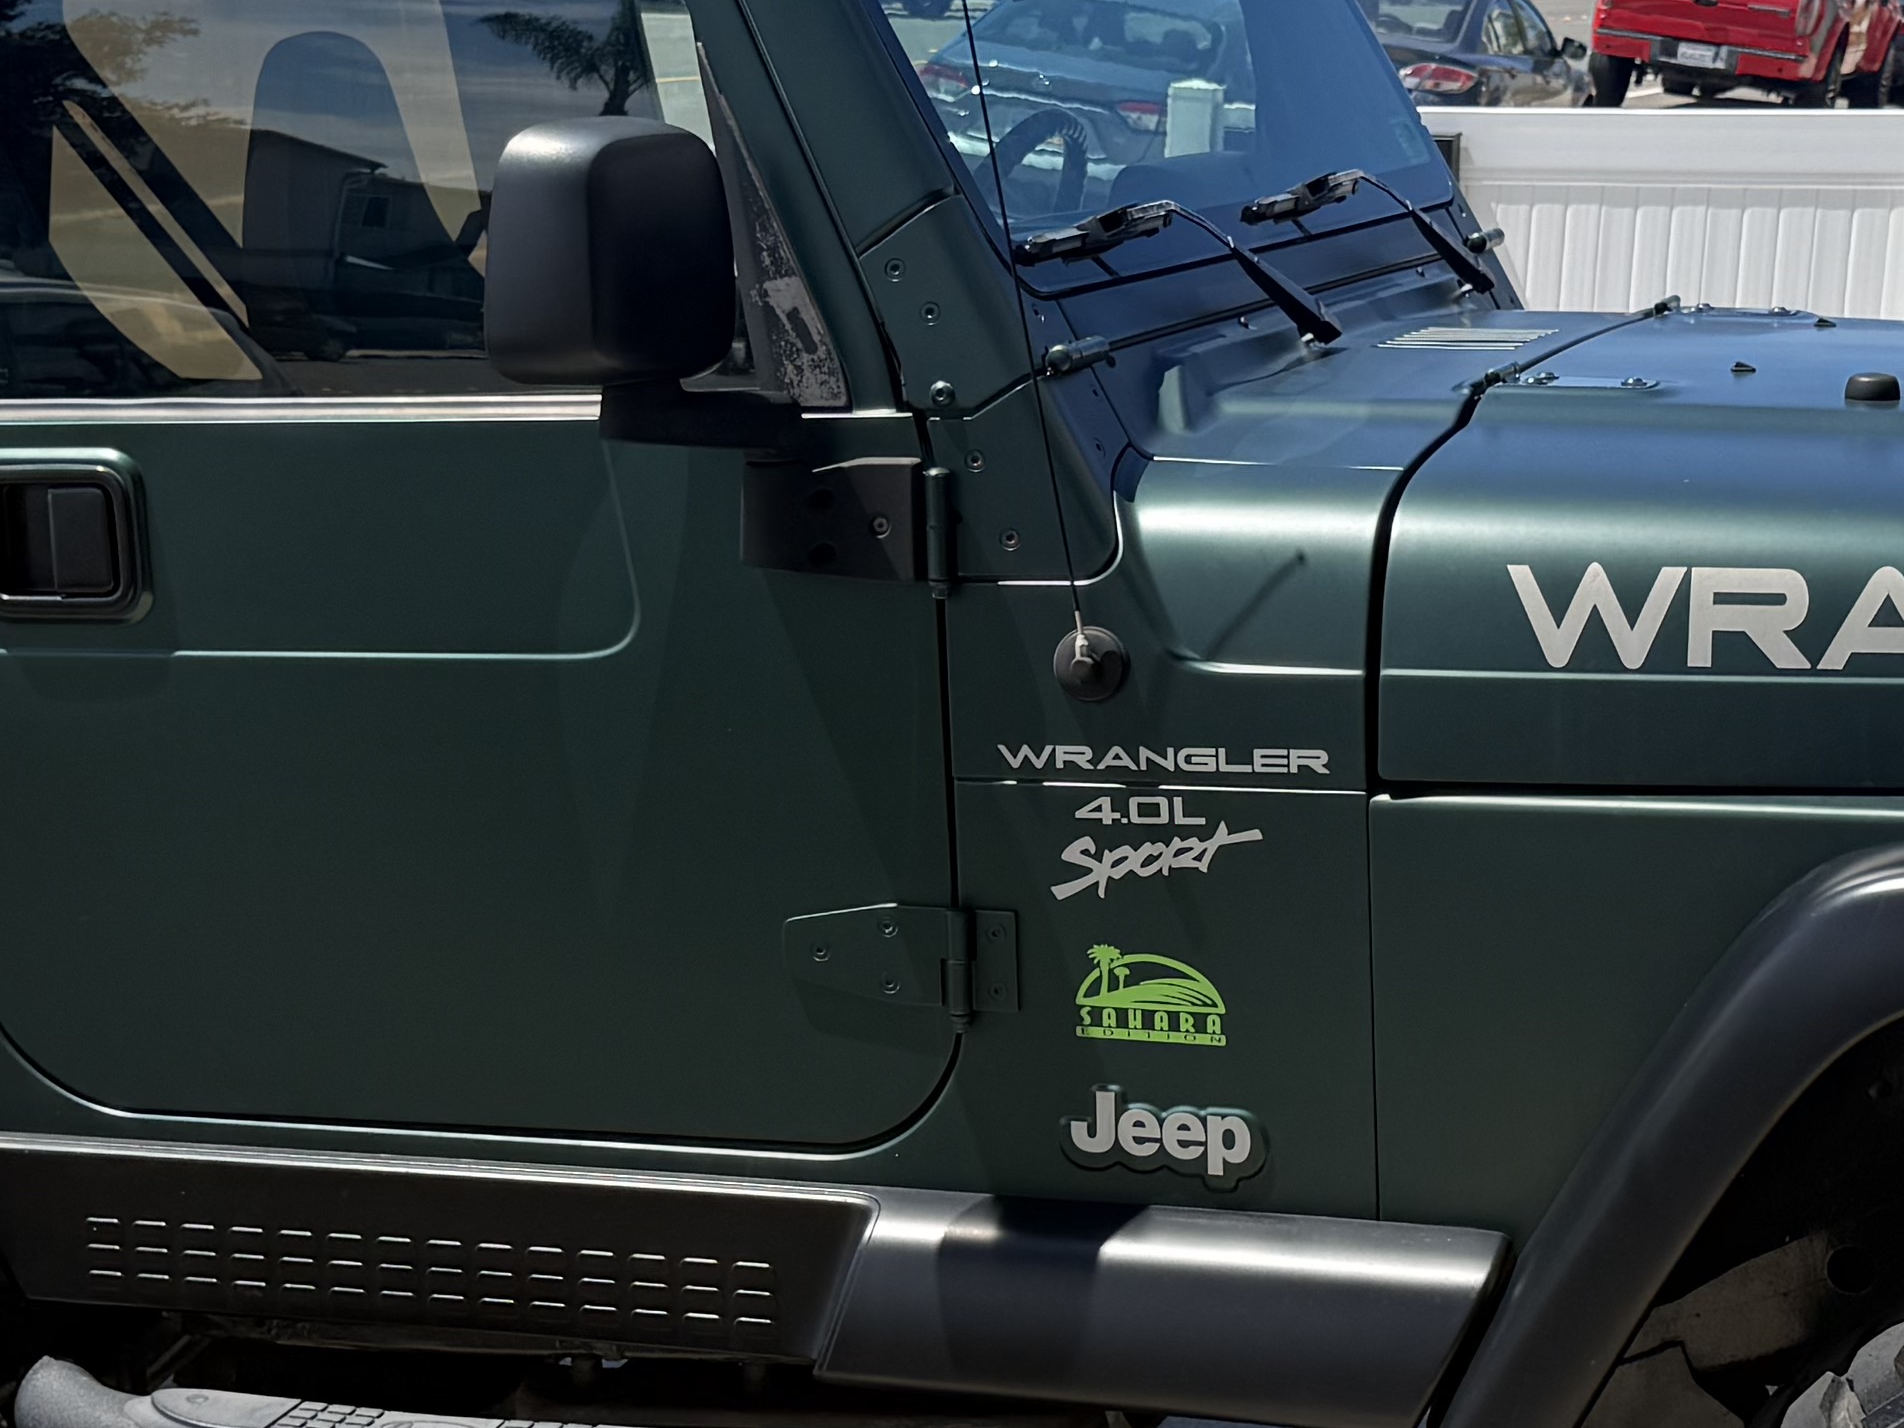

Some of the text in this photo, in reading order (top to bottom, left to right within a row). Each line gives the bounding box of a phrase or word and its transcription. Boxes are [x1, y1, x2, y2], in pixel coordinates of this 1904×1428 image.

[997, 744, 1330, 774] WRANGLER
[1074, 796, 1206, 825] 4.0L
[1079, 1006, 1222, 1034] SAHARA
[1080, 1027, 1222, 1044] EDITION
[1070, 1091, 1251, 1176] Jeep
